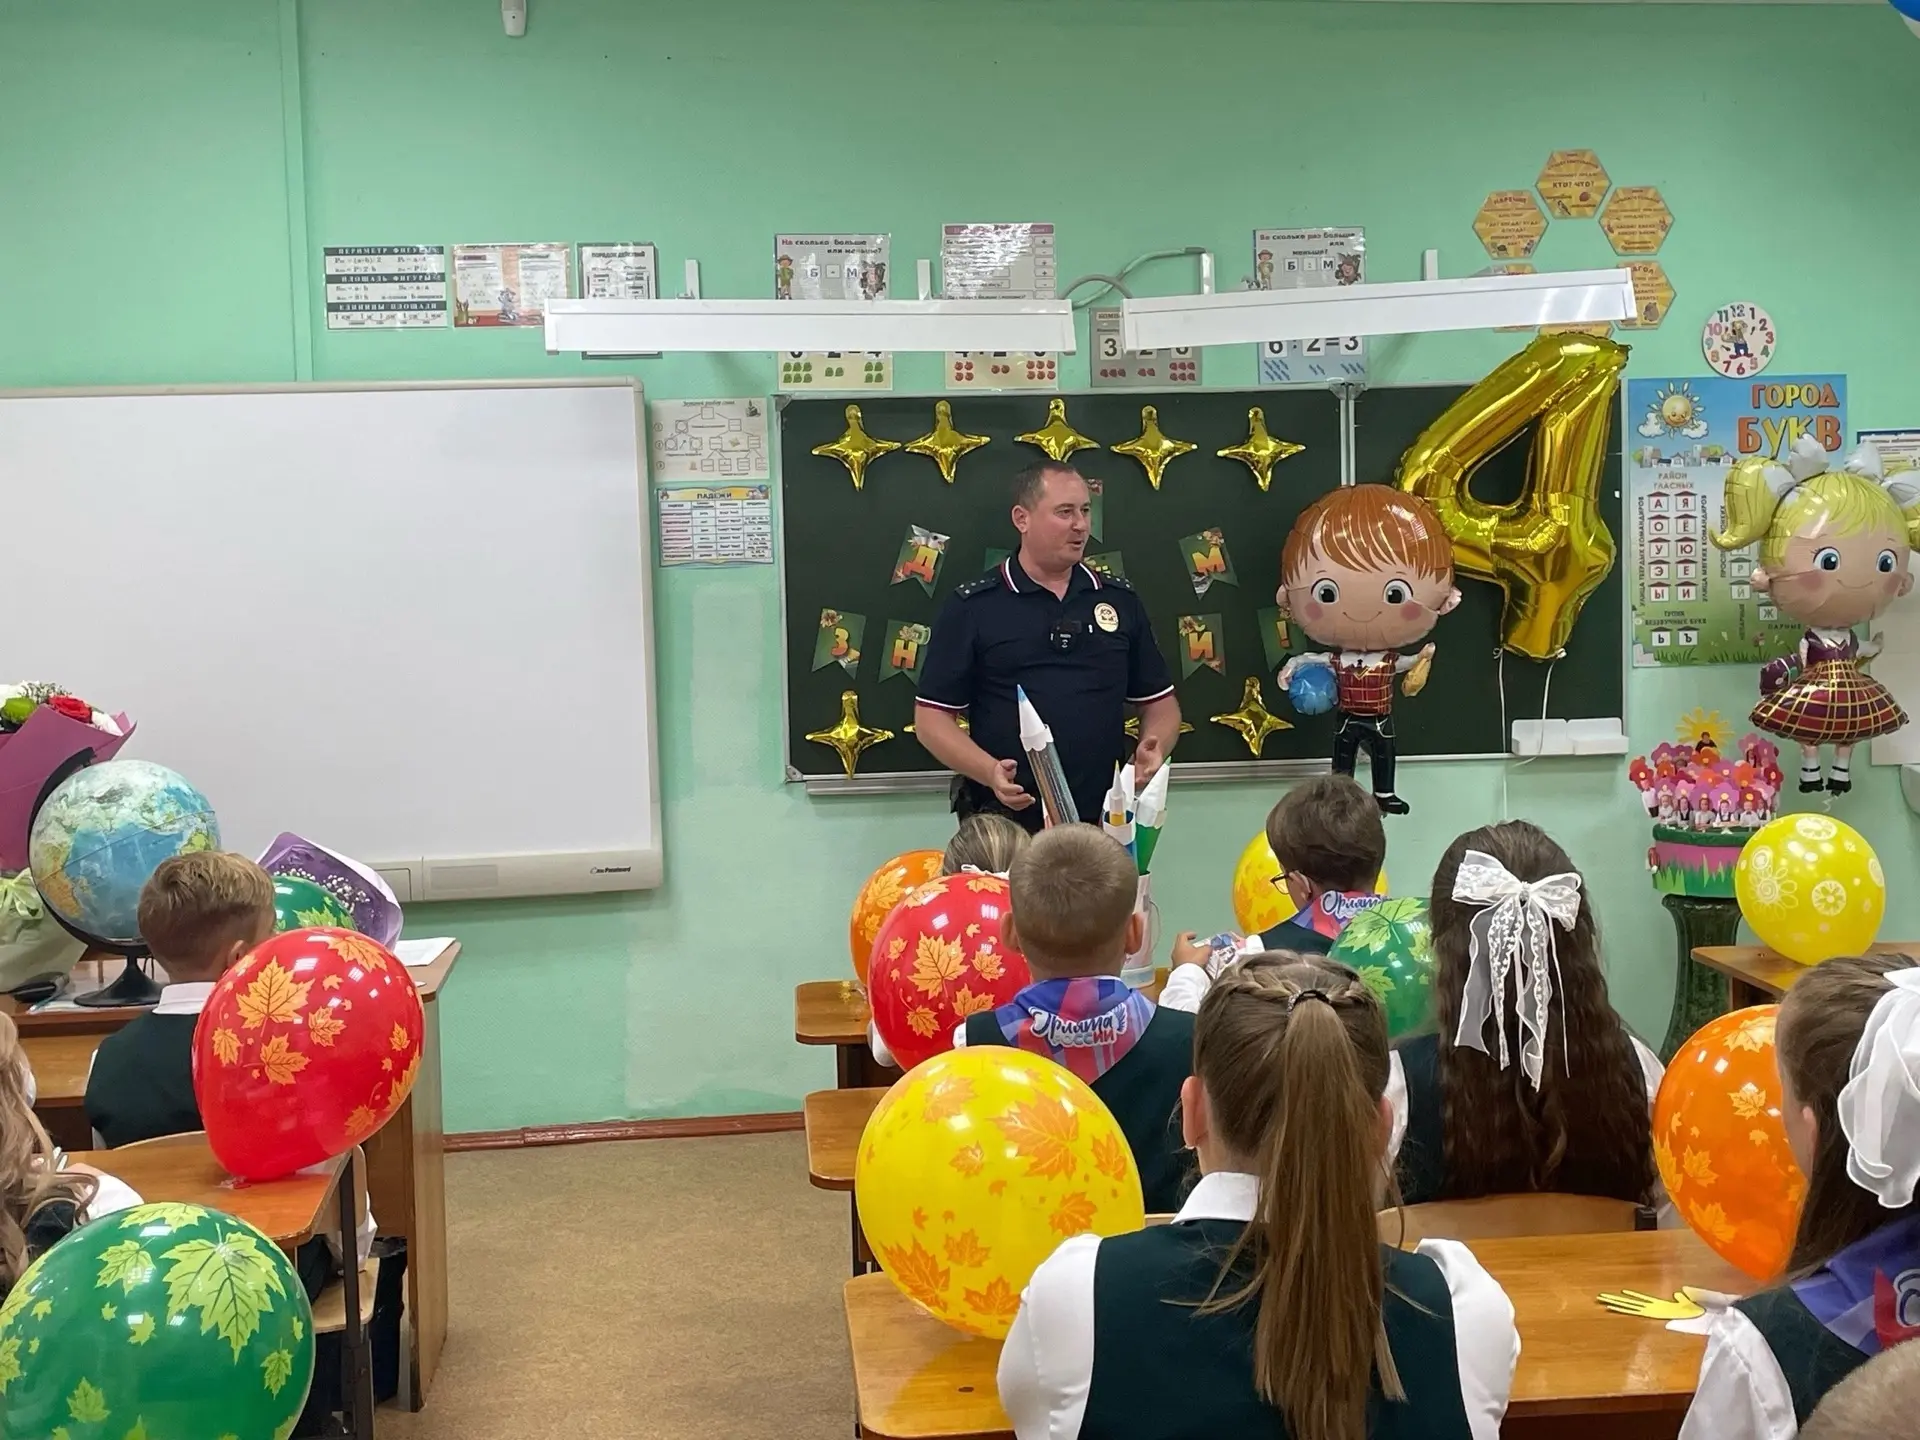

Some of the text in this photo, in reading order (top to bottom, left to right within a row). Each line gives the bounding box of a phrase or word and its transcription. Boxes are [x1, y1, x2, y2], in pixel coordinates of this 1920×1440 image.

[1288, 261, 1296, 270] Б
[1323, 260, 1333, 269] М
[1717, 310, 1729, 322] 11
[1730, 304, 1745, 317] 12
[1749, 307, 1755, 320] 1
[1707, 323, 1722, 336] 10
[1759, 318, 1768, 331] 2
[1705, 337, 1714, 350] 9
[1766, 331, 1774, 344] 3
[1104, 338, 1118, 357] 3
[1760, 345, 1770, 357] 4
[1711, 350, 1719, 362] 8
[1723, 360, 1731, 373] 7
[1737, 363, 1745, 375] 6
[1750, 358, 1758, 370] 5
[1752, 382, 1840, 409] ГОРОД
[1738, 415, 1842, 460] БУКВ
[1658, 471, 1688, 479] РАЙОН
[1396, 332, 1631, 662] 4
[1682, 498, 1689, 508] Я
[1654, 499, 1662, 508] А
[1654, 522, 1664, 532] О
[1655, 545, 1663, 554] У
[1680, 544, 1693, 554] Ю
[903, 546, 938, 583] Д
[1192, 547, 1226, 573] М
[1654, 566, 1664, 576] Э
[1683, 566, 1690, 575] Е
[1654, 589, 1664, 599] Ы
[1682, 589, 1690, 598] И
[1764, 609, 1774, 618] Ж
[891, 639, 918, 669] Н
[1323, 891, 1381, 914] Орлят
